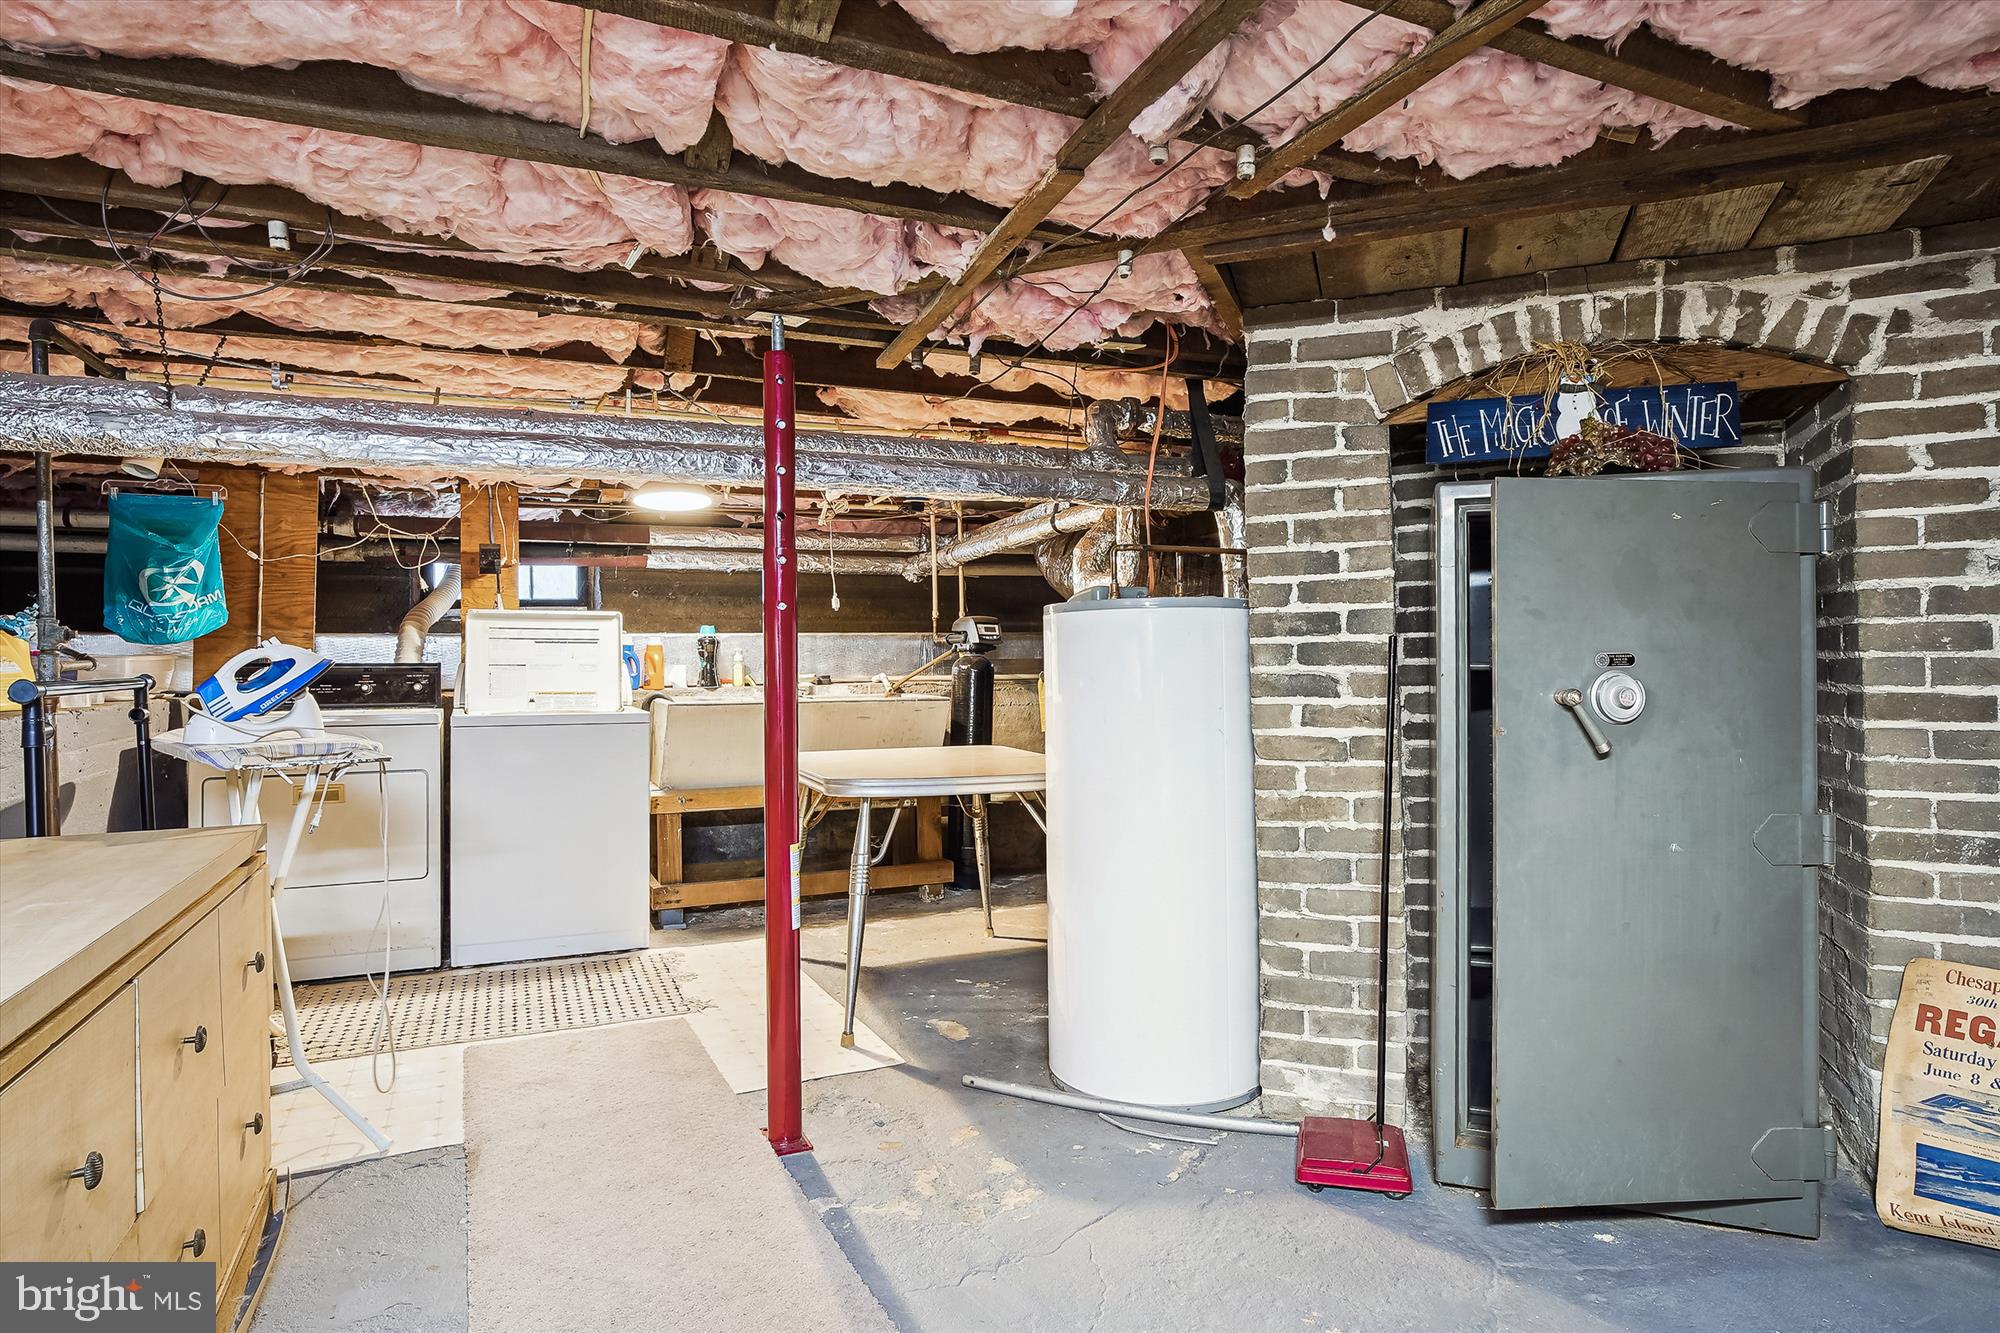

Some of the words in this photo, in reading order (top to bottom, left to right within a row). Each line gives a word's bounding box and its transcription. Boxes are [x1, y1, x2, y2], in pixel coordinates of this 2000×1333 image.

[1432, 414, 1476, 458] THE
[1642, 388, 1739, 441] WINTER
[1966, 995, 1998, 1010] 30th
[1914, 1003, 2000, 1049] REG
[1922, 1040, 1997, 1071] Saturday
[1923, 1062, 1961, 1081] June
[1970, 1072, 1981, 1086] 8
[1889, 1202, 1931, 1224] Kent
[1939, 1214, 1996, 1236] Island
